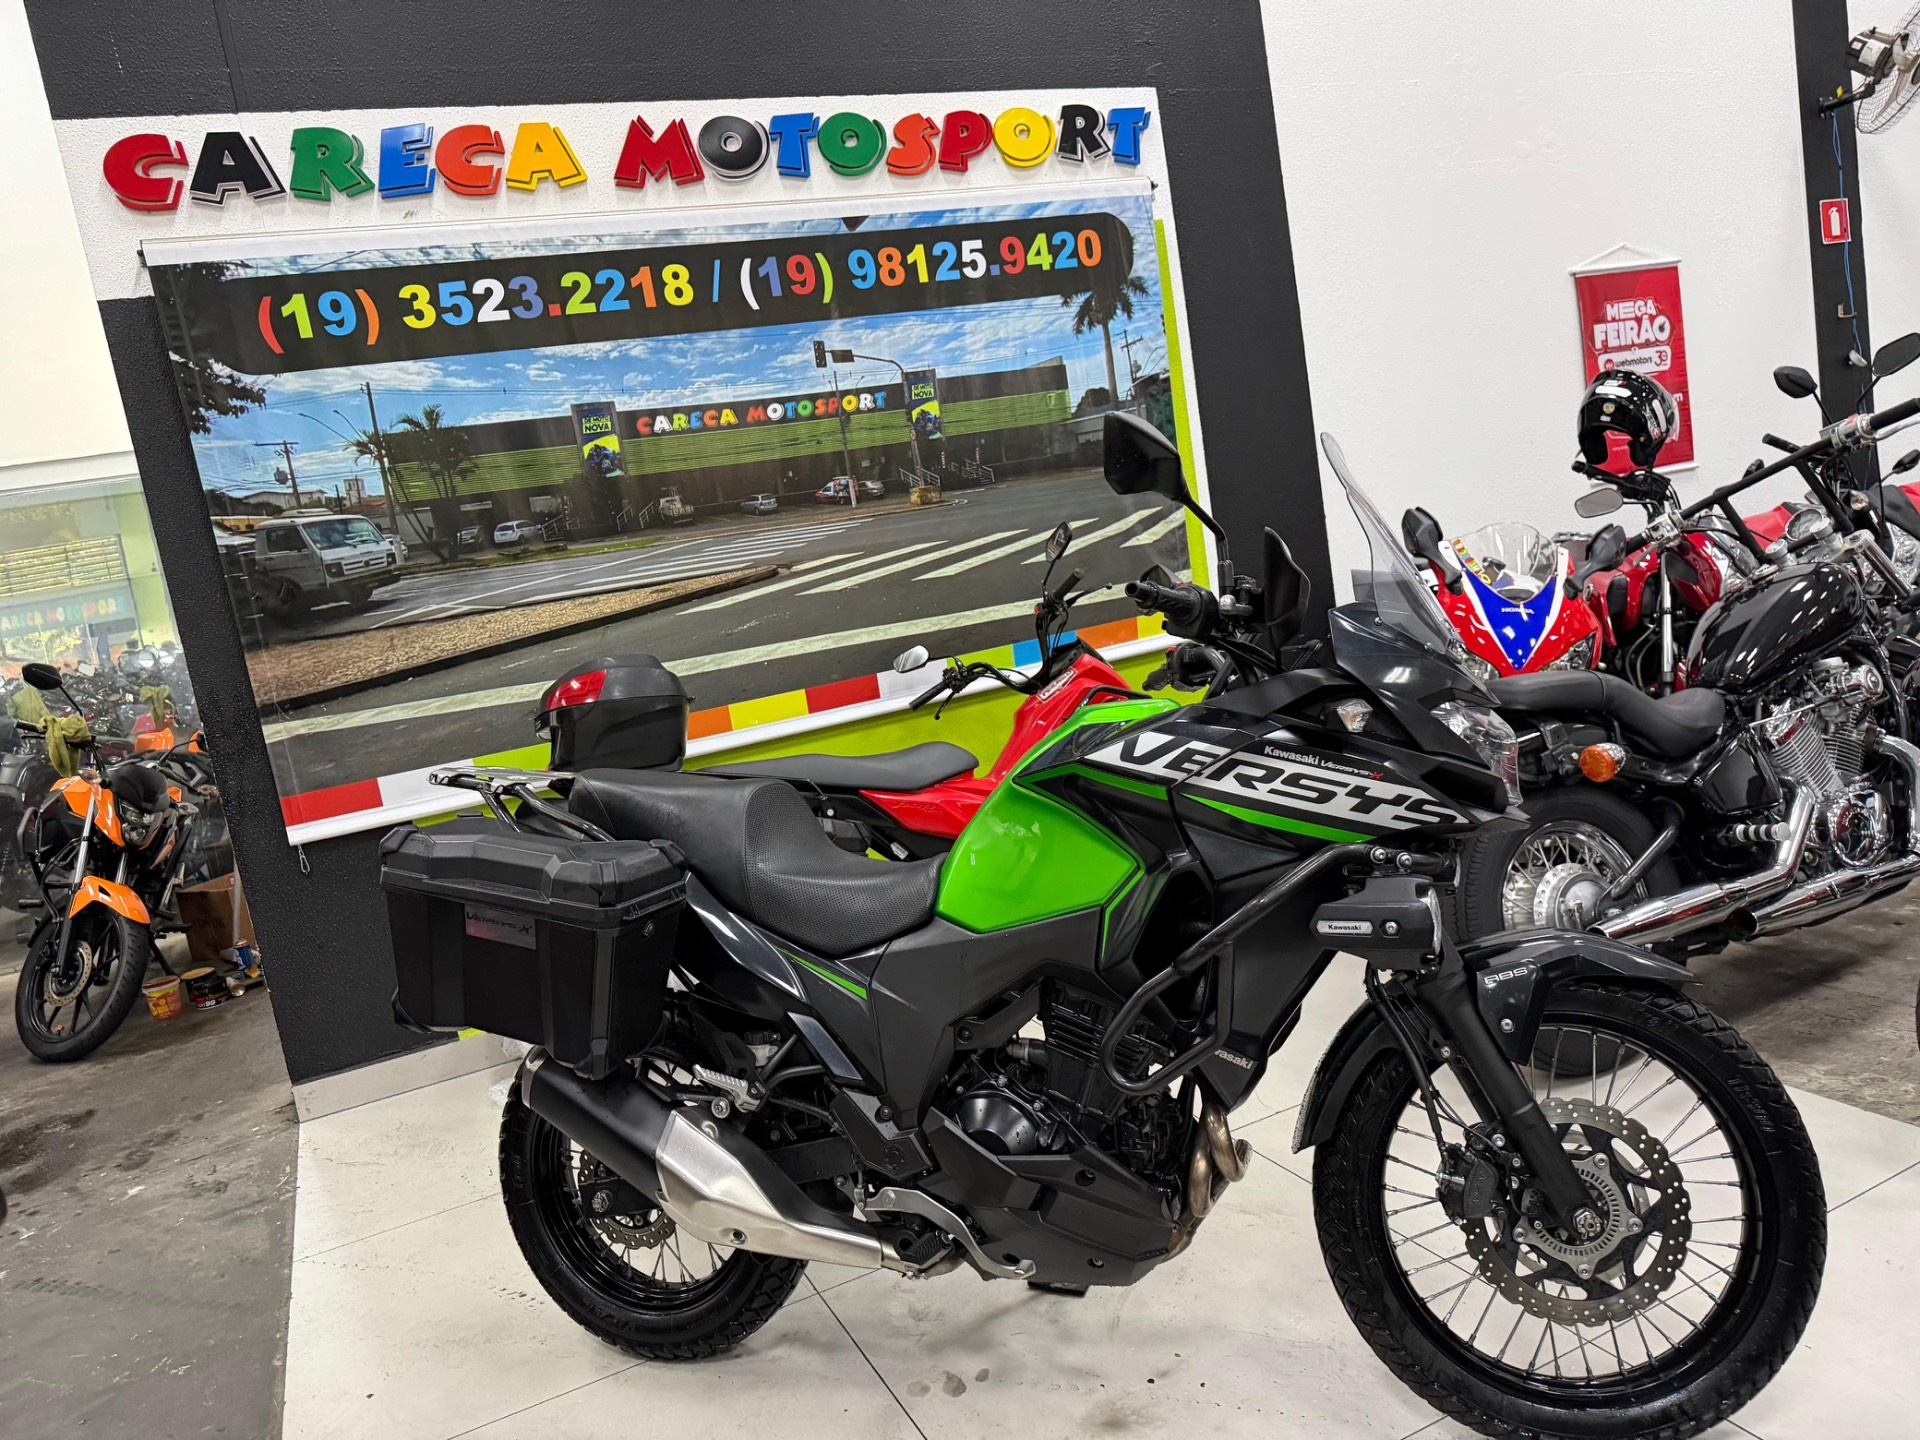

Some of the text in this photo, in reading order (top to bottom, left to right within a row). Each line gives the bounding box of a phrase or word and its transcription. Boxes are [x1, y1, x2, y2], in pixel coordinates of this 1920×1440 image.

[103, 104, 1151, 211] CARECA MOTOSPORT
[258, 229, 1102, 354] (19) 3523.2218 / (19) 98125.9420
[1606, 299, 1657, 321] MEGA
[1593, 315, 1671, 350] FEIRÃO
[1615, 355, 1653, 368] webmotors
[913, 389, 933, 399] NOVA
[636, 390, 887, 436] CARECA MOTOSPORT
[584, 422, 610, 433] NOVA
[1, 610, 43, 631] ARECA
[1264, 745, 1320, 766] Kawasaki
[1119, 734, 1458, 828] VERSYS
[1484, 966, 1528, 986] ABS
[1214, 1049, 1254, 1070] asaki
